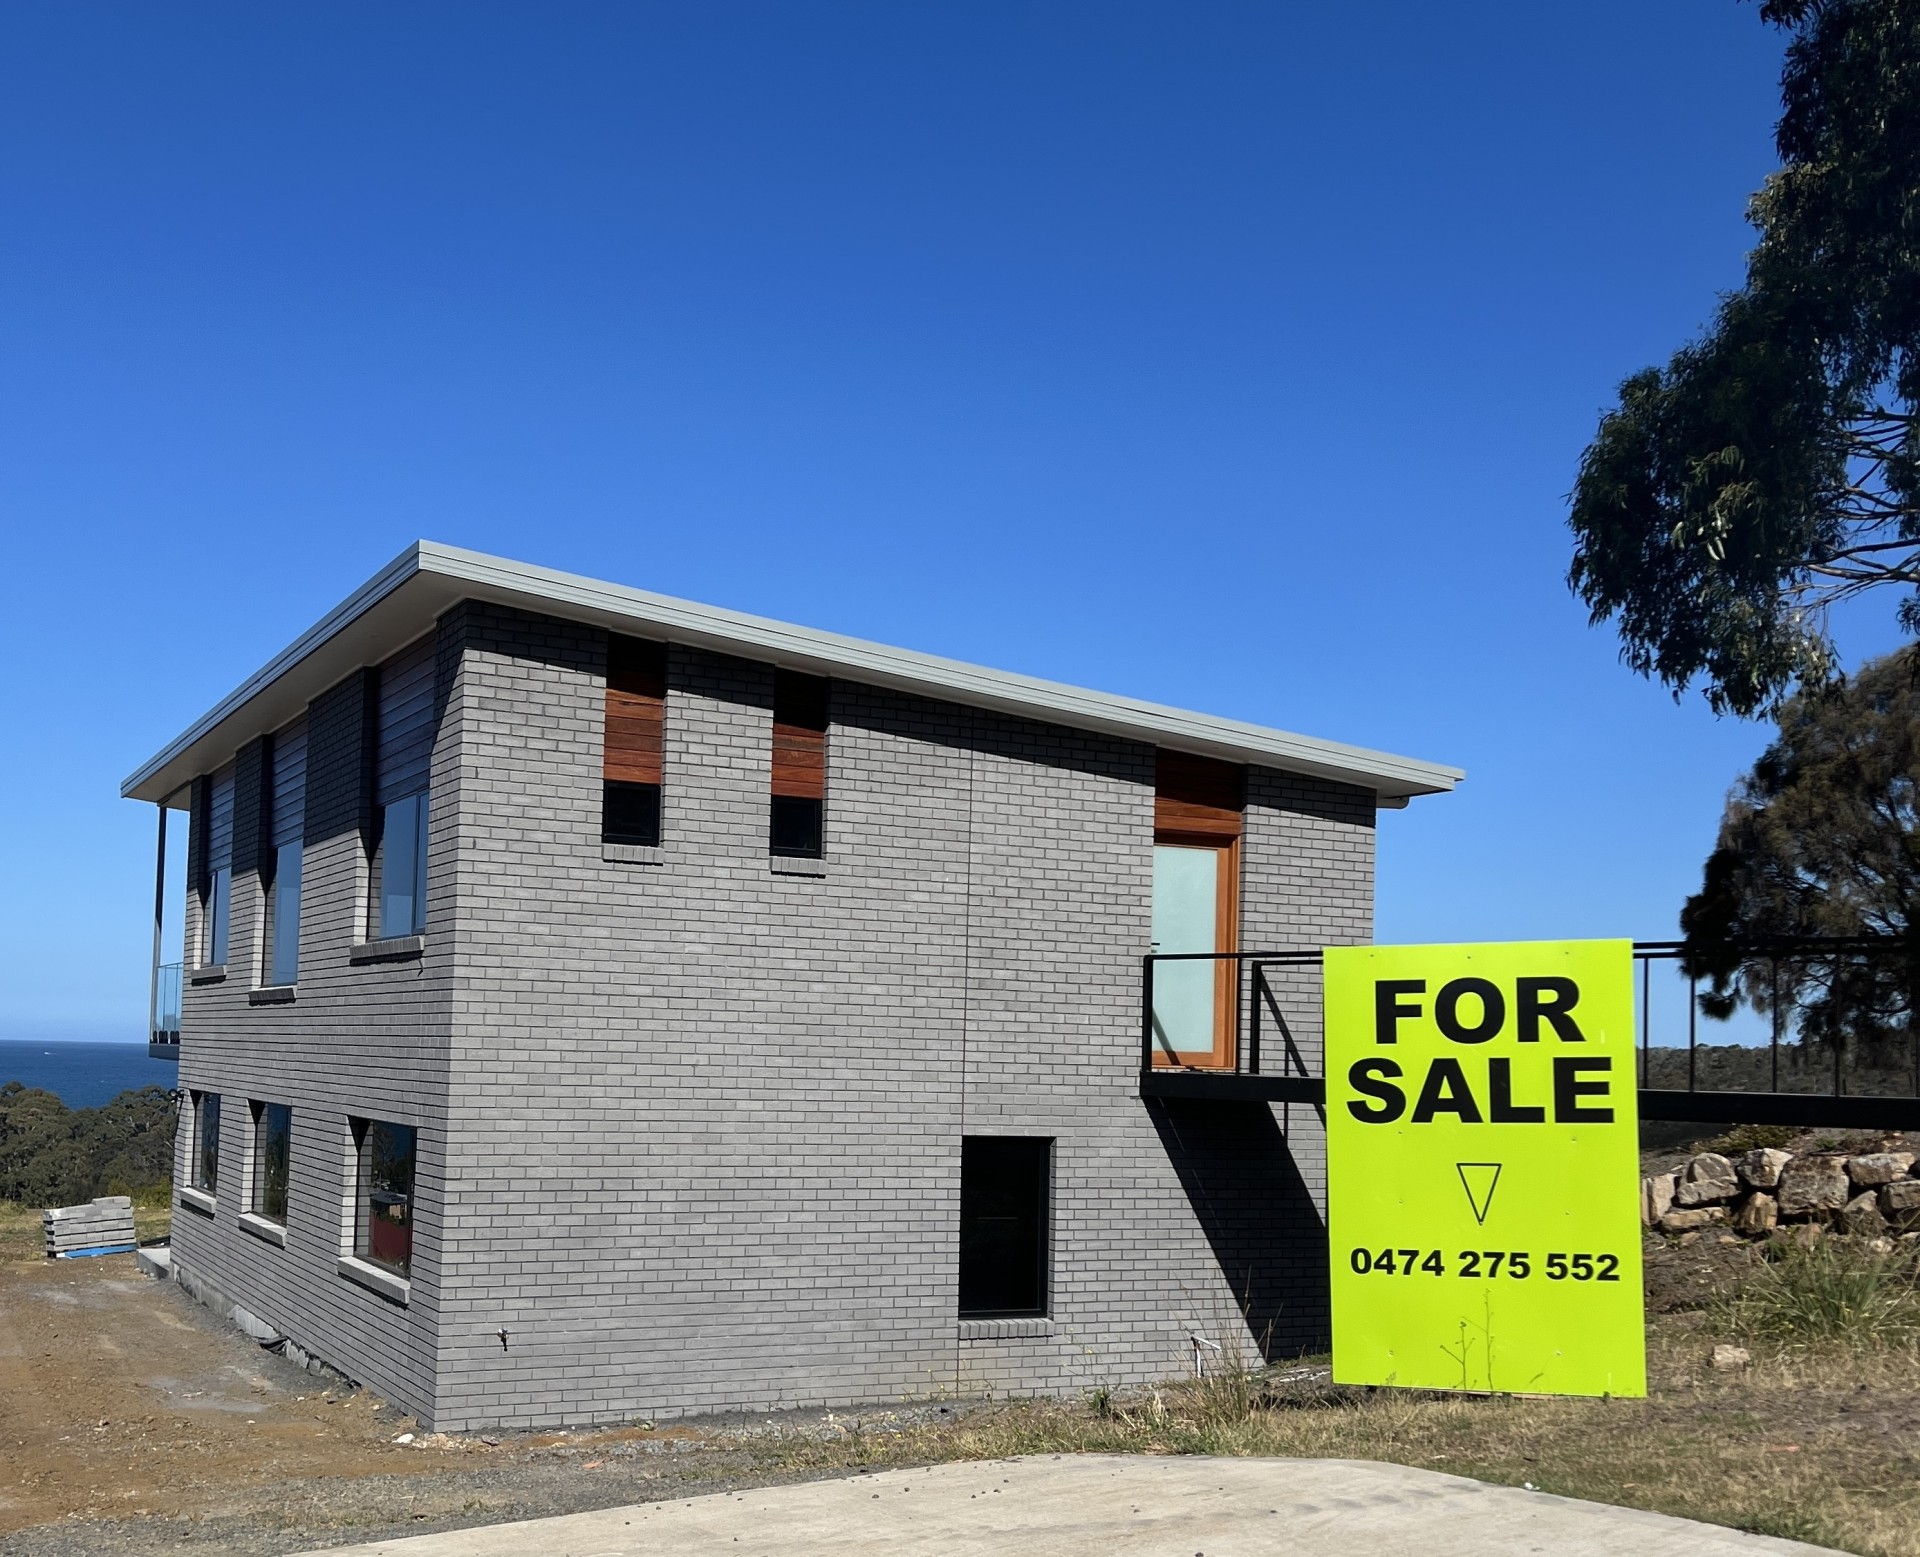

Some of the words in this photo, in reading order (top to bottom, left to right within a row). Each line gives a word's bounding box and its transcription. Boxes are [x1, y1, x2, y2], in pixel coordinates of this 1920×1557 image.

[1375, 976, 1586, 1045] FOR
[1346, 1057, 1615, 1124] SALE
[1350, 1247, 1445, 1277] 0474
[1458, 1250, 1531, 1279] 275
[1545, 1253, 1621, 1282] 552
